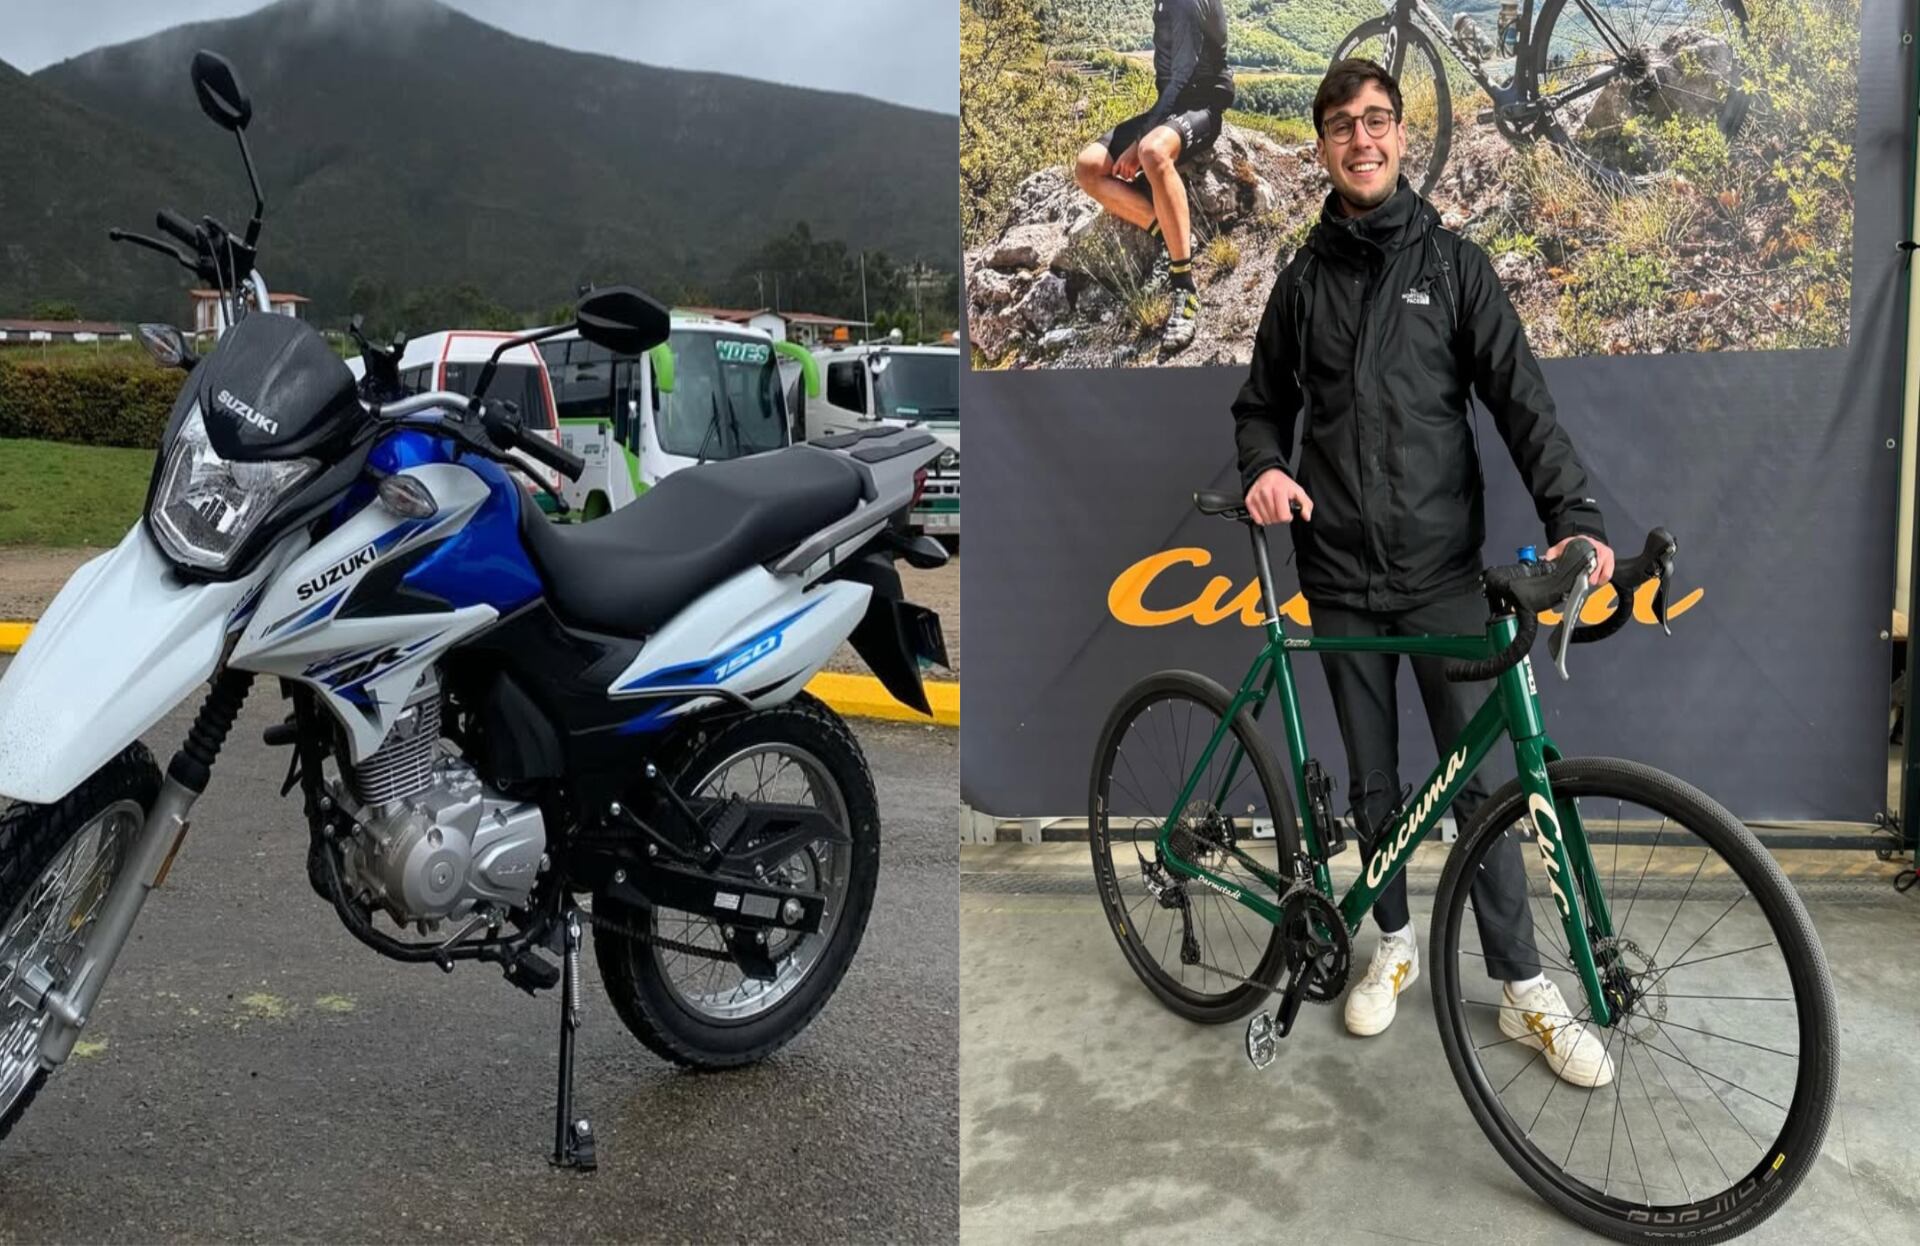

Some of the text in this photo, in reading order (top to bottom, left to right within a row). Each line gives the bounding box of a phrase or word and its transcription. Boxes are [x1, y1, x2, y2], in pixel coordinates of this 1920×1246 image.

[218, 389, 279, 435] SUZUKI
[297, 546, 376, 601] SUZUKI
[714, 635, 777, 681] 150
[1366, 745, 1467, 889] Cucuma
